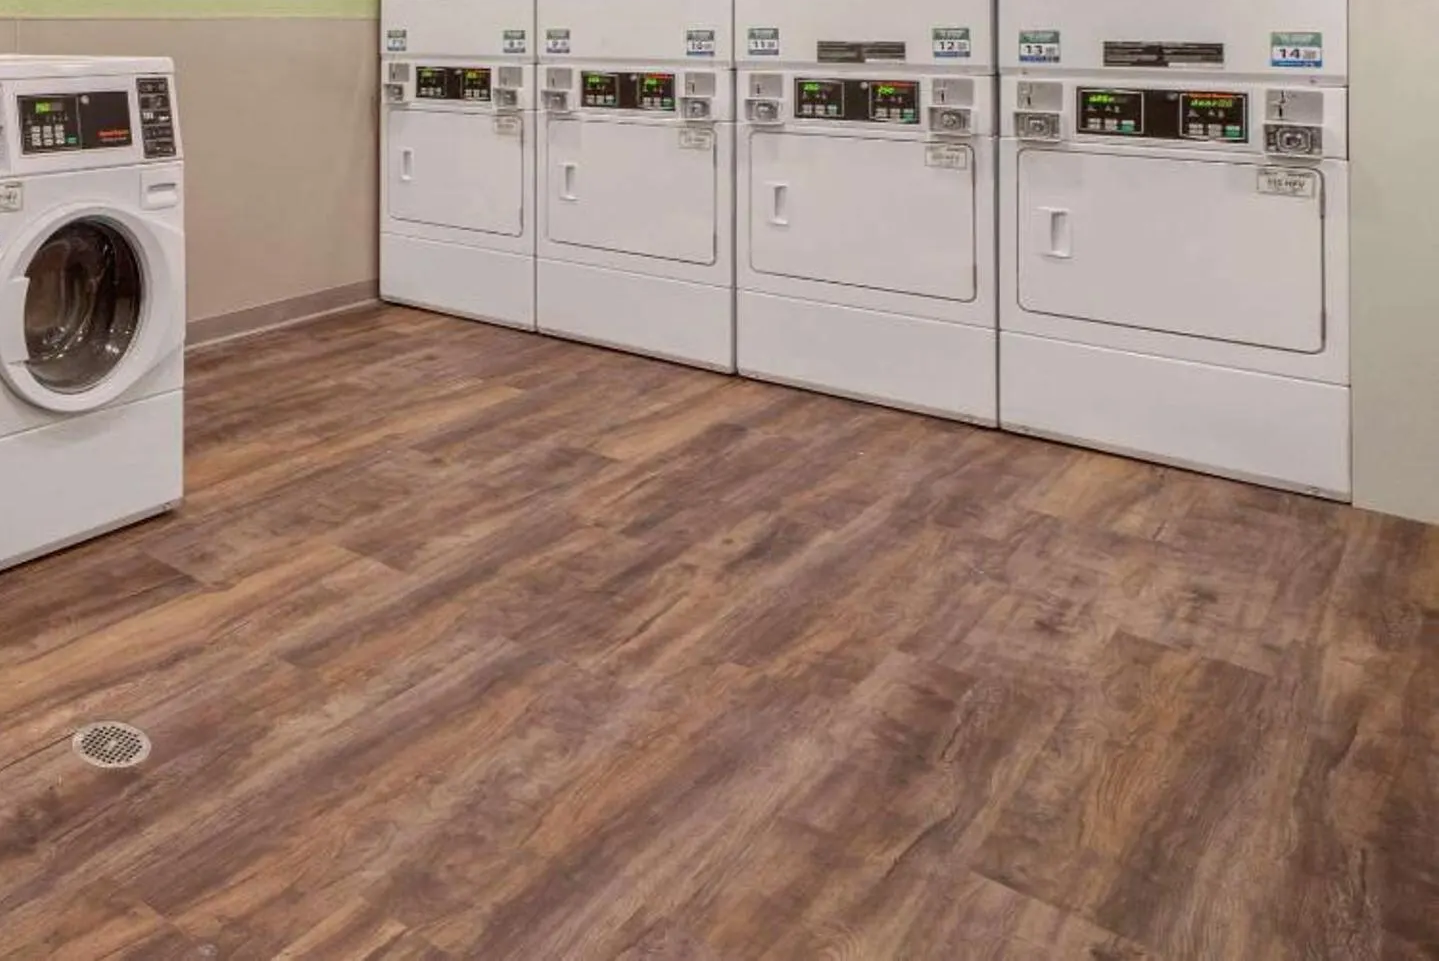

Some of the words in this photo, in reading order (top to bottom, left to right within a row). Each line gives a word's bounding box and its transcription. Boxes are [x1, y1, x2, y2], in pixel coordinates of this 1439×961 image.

[939, 41, 954, 51] 12
[1025, 44, 1043, 55] 13
[1279, 48, 1300, 58] 14
